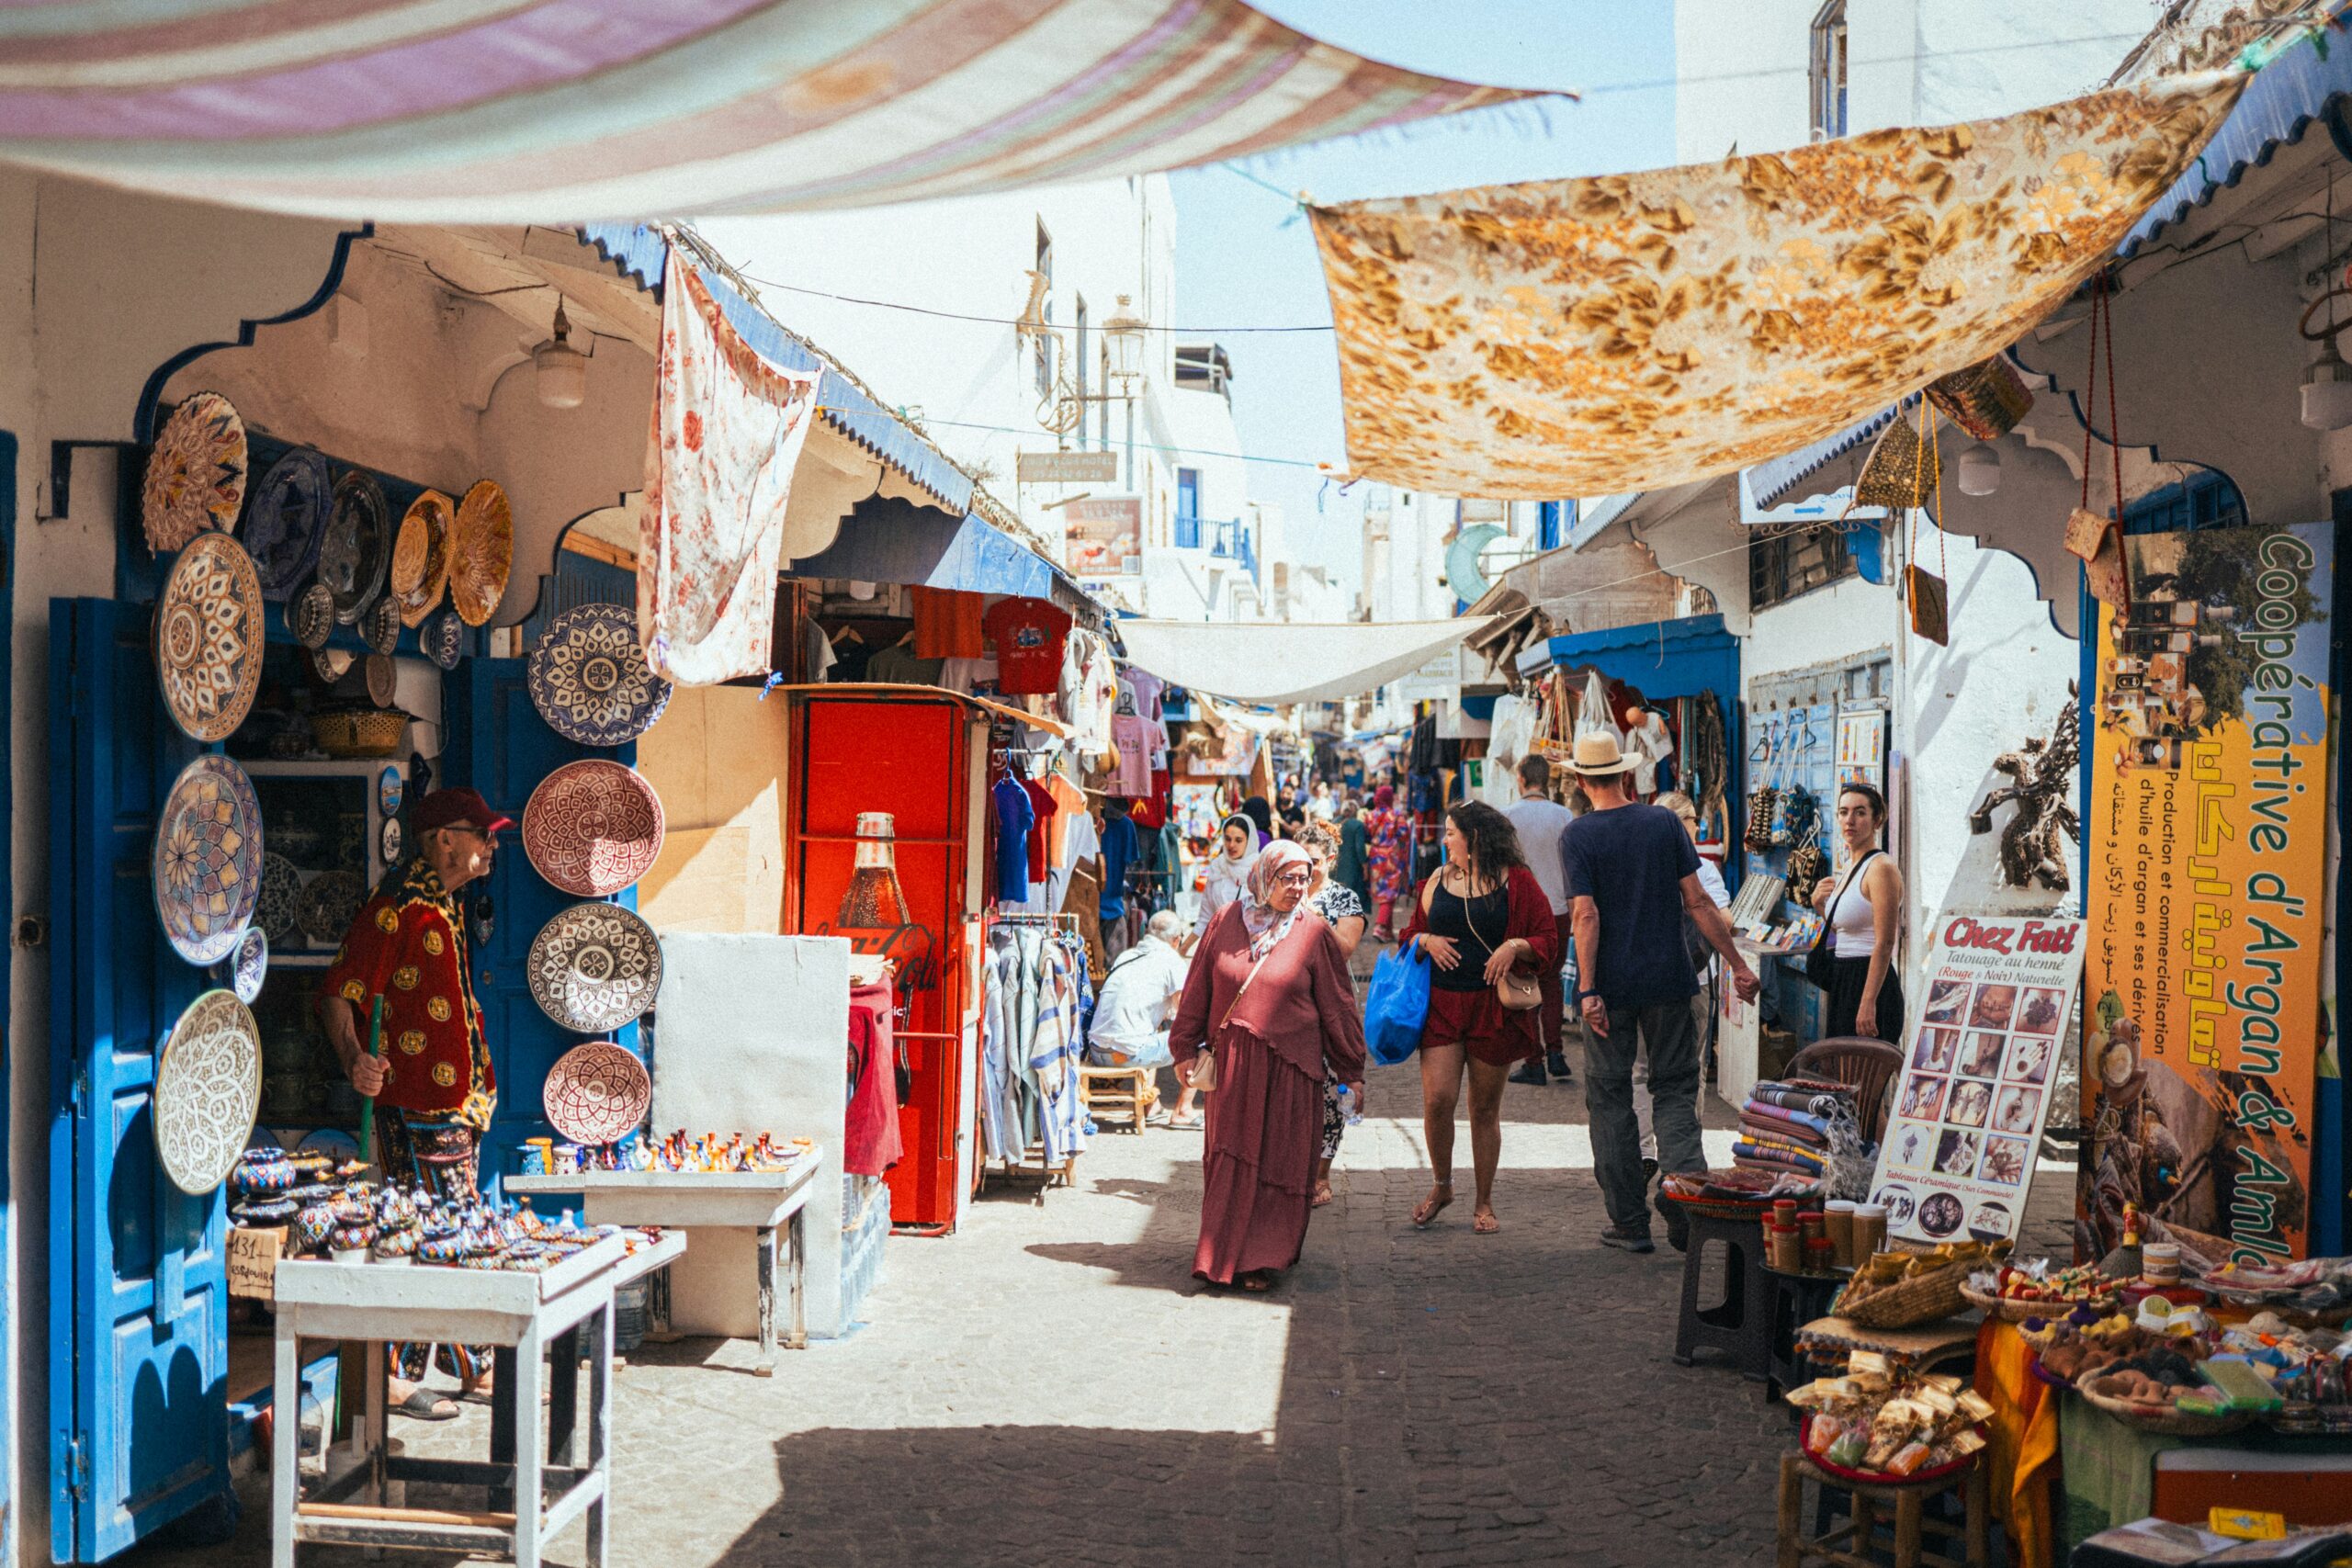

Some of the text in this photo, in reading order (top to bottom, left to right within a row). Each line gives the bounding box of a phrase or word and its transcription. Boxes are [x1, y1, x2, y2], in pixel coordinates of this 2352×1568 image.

[2237, 534, 2315, 852] Coopérative
[2138, 779, 2155, 838] d'huile
[2130, 843, 2154, 913] d'argan
[2102, 902, 2118, 934] زيت
[2154, 772, 2179, 1055] Production et commercialisation
[2181, 742, 2235, 1070] تعاونية اركان
[1944, 918, 2079, 955] Chez Fati
[2133, 920, 2147, 937] et
[1938, 966, 1973, 980] (Rouge
[1984, 970, 2012, 982] Noir)
[2014, 974, 2065, 986] Naturelle
[1947, 951, 2065, 971] Tatouage au henné
[2133, 944, 2145, 971] ses
[2226, 872, 2305, 1076] d'Argan
[2130, 977, 2148, 1043] dérivés
[2235, 1092, 2294, 1129] &
[1885, 1169, 1919, 1184] Tableaux
[1919, 1176, 1961, 1193] Céramique
[1976, 1186, 2014, 1200] Commande)
